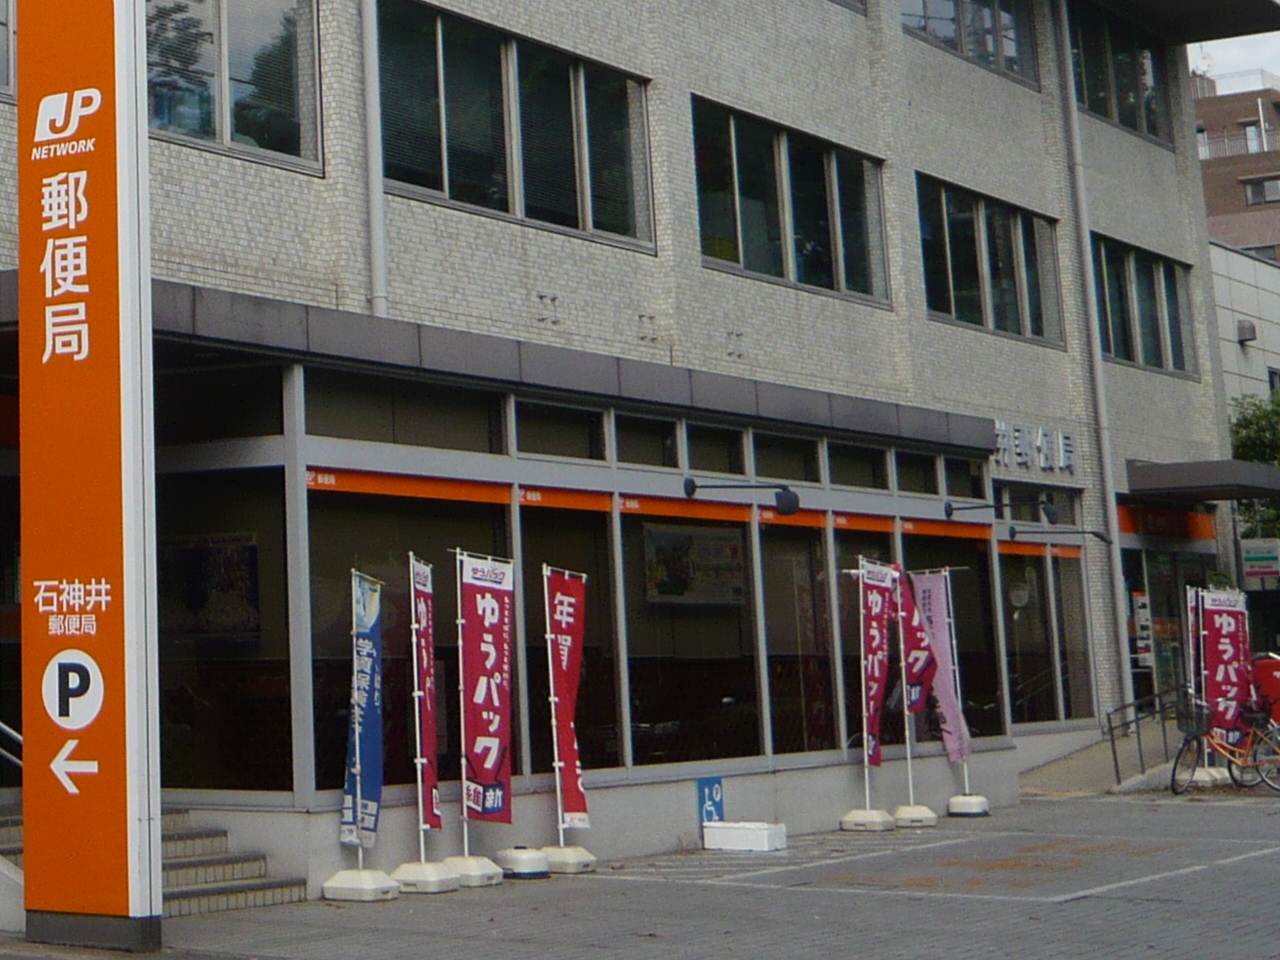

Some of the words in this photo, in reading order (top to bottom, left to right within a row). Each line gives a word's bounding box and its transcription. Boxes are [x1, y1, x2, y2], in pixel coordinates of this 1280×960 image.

[33, 87, 102, 142] JP
[31, 137, 96, 160] NETWORK
[39, 170, 90, 364] 郵便局
[33, 577, 112, 613] 石神井
[48, 613, 97, 637] 郵便局
[57, 662, 91, 717] P
[473, 592, 500, 769] ゆうパック
[1214, 612, 1238, 721] ゆうパック
